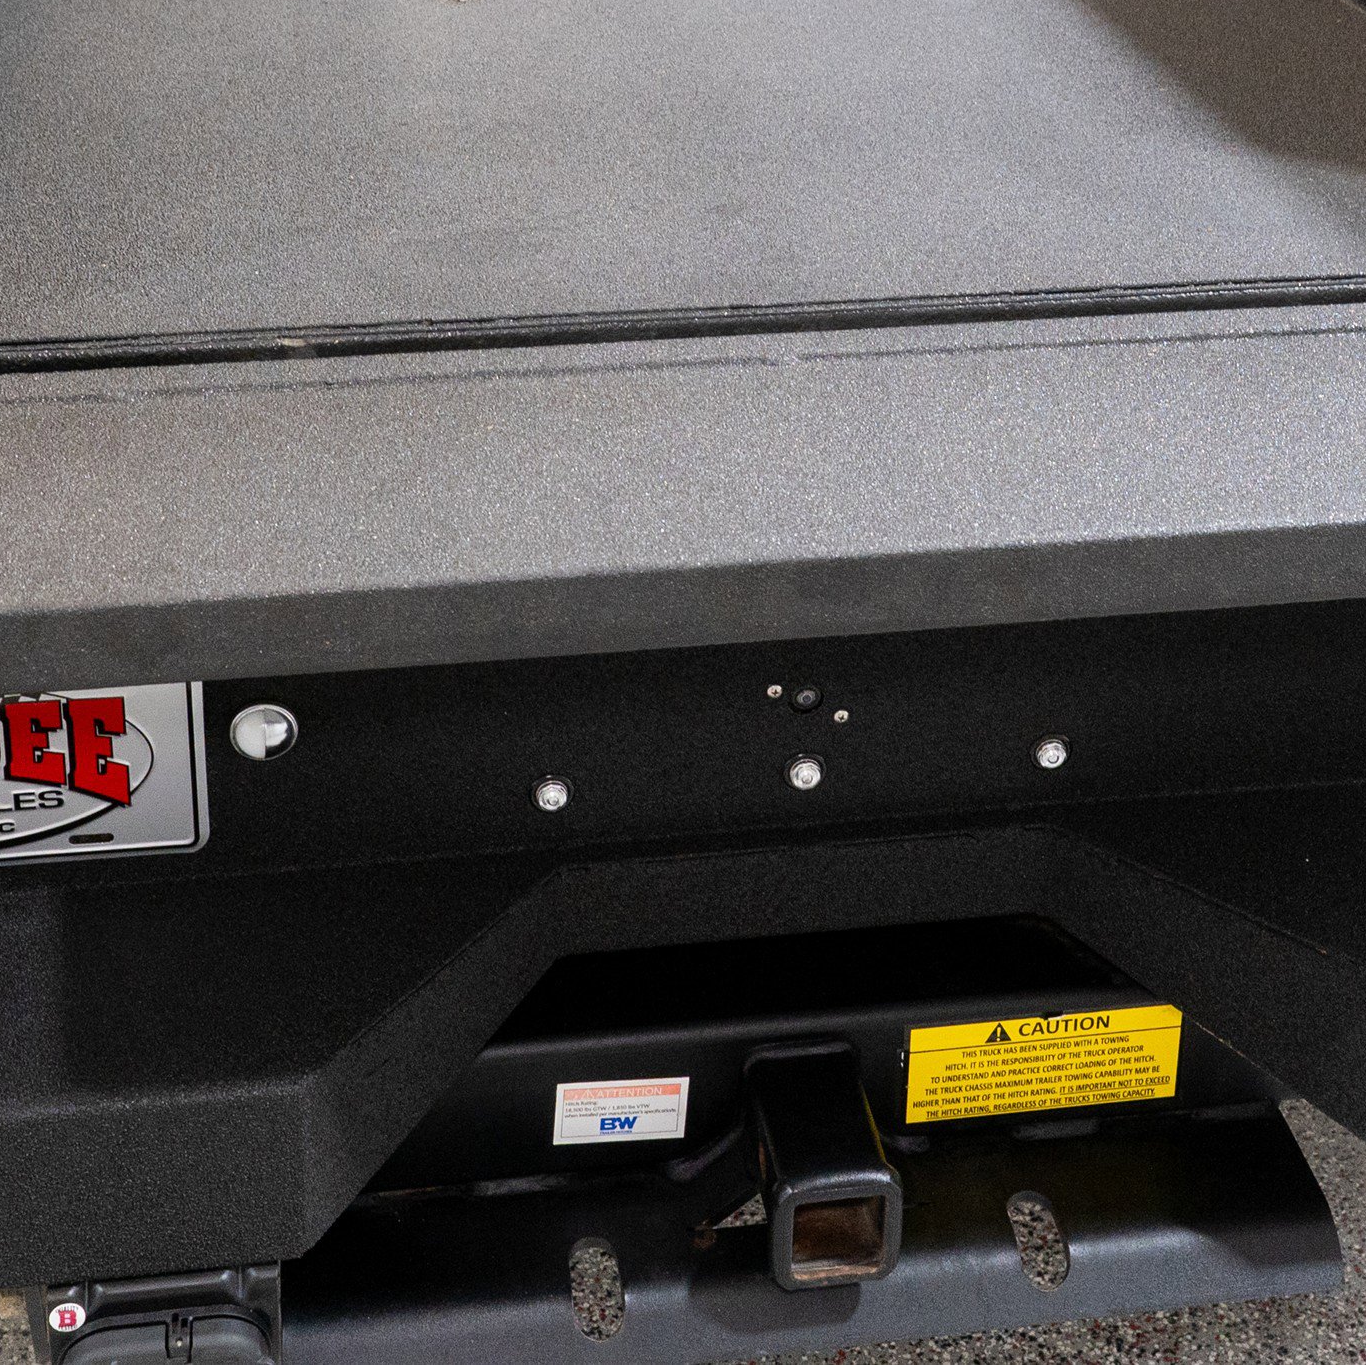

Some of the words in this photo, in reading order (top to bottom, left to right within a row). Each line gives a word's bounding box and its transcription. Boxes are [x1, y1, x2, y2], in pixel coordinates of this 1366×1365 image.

[1018, 1015, 1110, 1036] CAUTION
[962, 1050, 978, 1059] THIS
[979, 1048, 1002, 1057] TRUCK
[1003, 1046, 1018, 1055] HAS
[1019, 1044, 1037, 1053] BEEN
[1039, 1041, 1071, 1051] SUPPLIED
[1073, 1039, 1092, 1048] WITH
[1101, 1035, 1129, 1045] TOWING
[987, 1059, 1000, 1067] THE
[1001, 1054, 1055, 1066] RESPONSIBILITY
[1069, 1051, 1081, 1059] THE
[1084, 1049, 1106, 1058] TRUCK
[1107, 1045, 1144, 1055] OPERATOR
[925, 1088, 938, 1096] THE
[940, 1085, 963, 1094] TRUCK
[965, 1082, 993, 1092] CHASSIS
[995, 1078, 1033, 1089] MAXIMUM
[1035, 1075, 1063, 1085] TRAILER
[1064, 1072, 1093, 1082] TOWING
[1095, 1068, 1133, 1079] CAPABILITY
[1134, 1067, 1150, 1075] MAY
[942, 1071, 989, 1083] UNDERSTAND
[991, 1069, 1007, 1078] AND
[1008, 1066, 1041, 1076] PRACTICE
[1042, 1063, 1074, 1073] CORRECT
[1075, 1060, 1107, 1070] LOADING
[1119, 1057, 1132, 1065] THE
[596, 1087, 663, 1098] ATTENTION
[913, 1099, 939, 1108] HIGHER
[941, 1096, 961, 1105] THAN
[963, 1095, 980, 1103] THAT
[993, 1092, 1007, 1100] THE
[1008, 1090, 1029, 1099] HITCH
[1075, 1081, 1117, 1092] IMPORTANT
[1118, 1080, 1132, 1088] NOT
[1145, 1076, 1171, 1085] EXCEED
[926, 1110, 940, 1118] THE
[941, 1108, 962, 1117] HITCH
[993, 1101, 1037, 1112] REGARDLESS
[1049, 1098, 1062, 1106] THE
[1064, 1096, 1091, 1105] TRUCKS
[1092, 1093, 1121, 1102] TOWING
